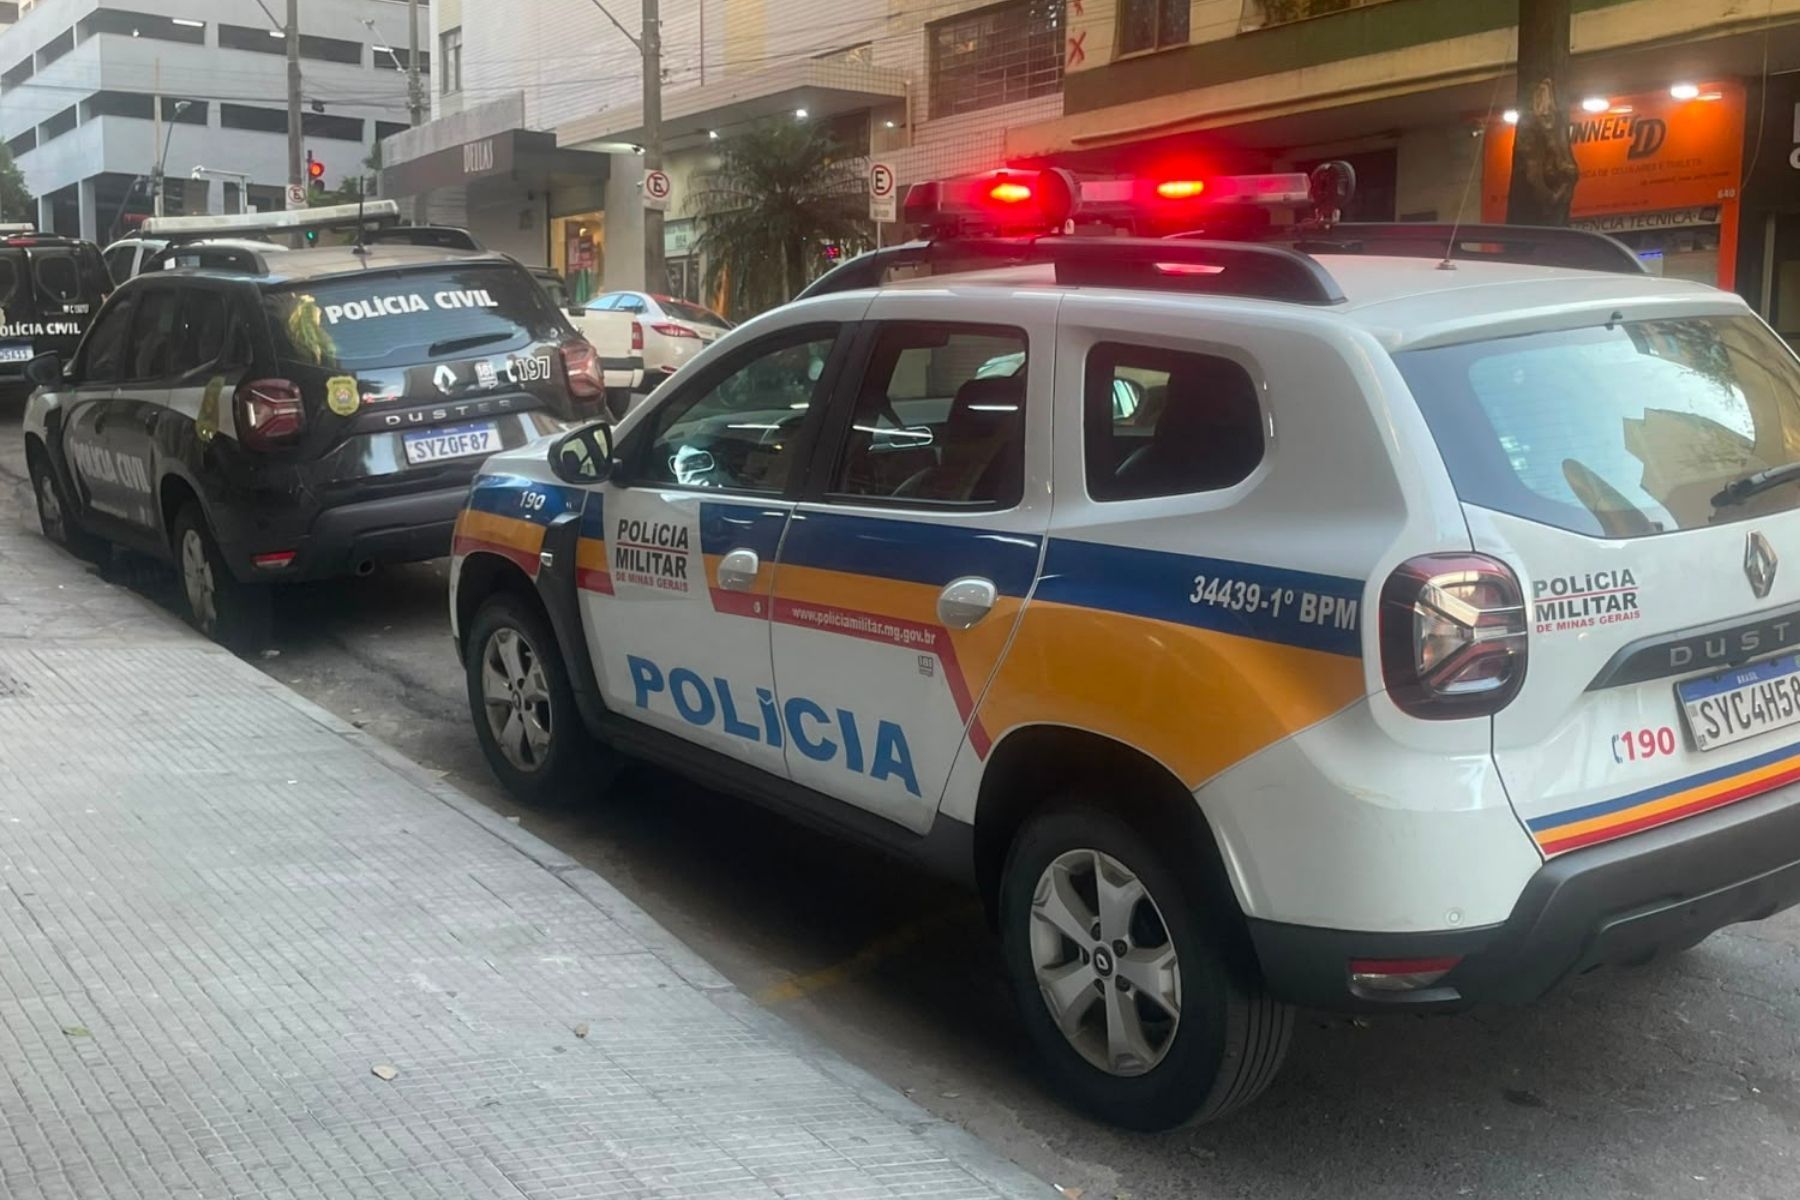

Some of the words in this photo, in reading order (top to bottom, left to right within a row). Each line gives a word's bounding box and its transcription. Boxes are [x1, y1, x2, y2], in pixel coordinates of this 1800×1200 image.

[875, 170, 885, 190] E
[325, 294, 430, 324] POLÍCIA
[434, 289, 499, 309] CIVIL
[0, 321, 44, 337] OLÍCIA
[46, 322, 81, 335] CIVIL
[516, 355, 551, 381] 197
[385, 400, 512, 425] DUSTER
[116, 452, 151, 494] CIVIL
[520, 490, 546, 511] 190
[616, 547, 687, 579] MILITAR
[616, 571, 626, 582] DE
[628, 573, 654, 586] MINAS
[656, 578, 689, 592] GERAIS
[1299, 592, 1358, 630] BPM
[1535, 592, 1639, 622] MILITAR
[1536, 623, 1553, 634] DE
[1556, 617, 1596, 632] MINAS
[1599, 610, 1641, 625] GERAIS
[792, 607, 936, 645] www.policiamilitar.mg.gov.br
[1669, 622, 1791, 667] DUST
[1621, 727, 1676, 761] 190
